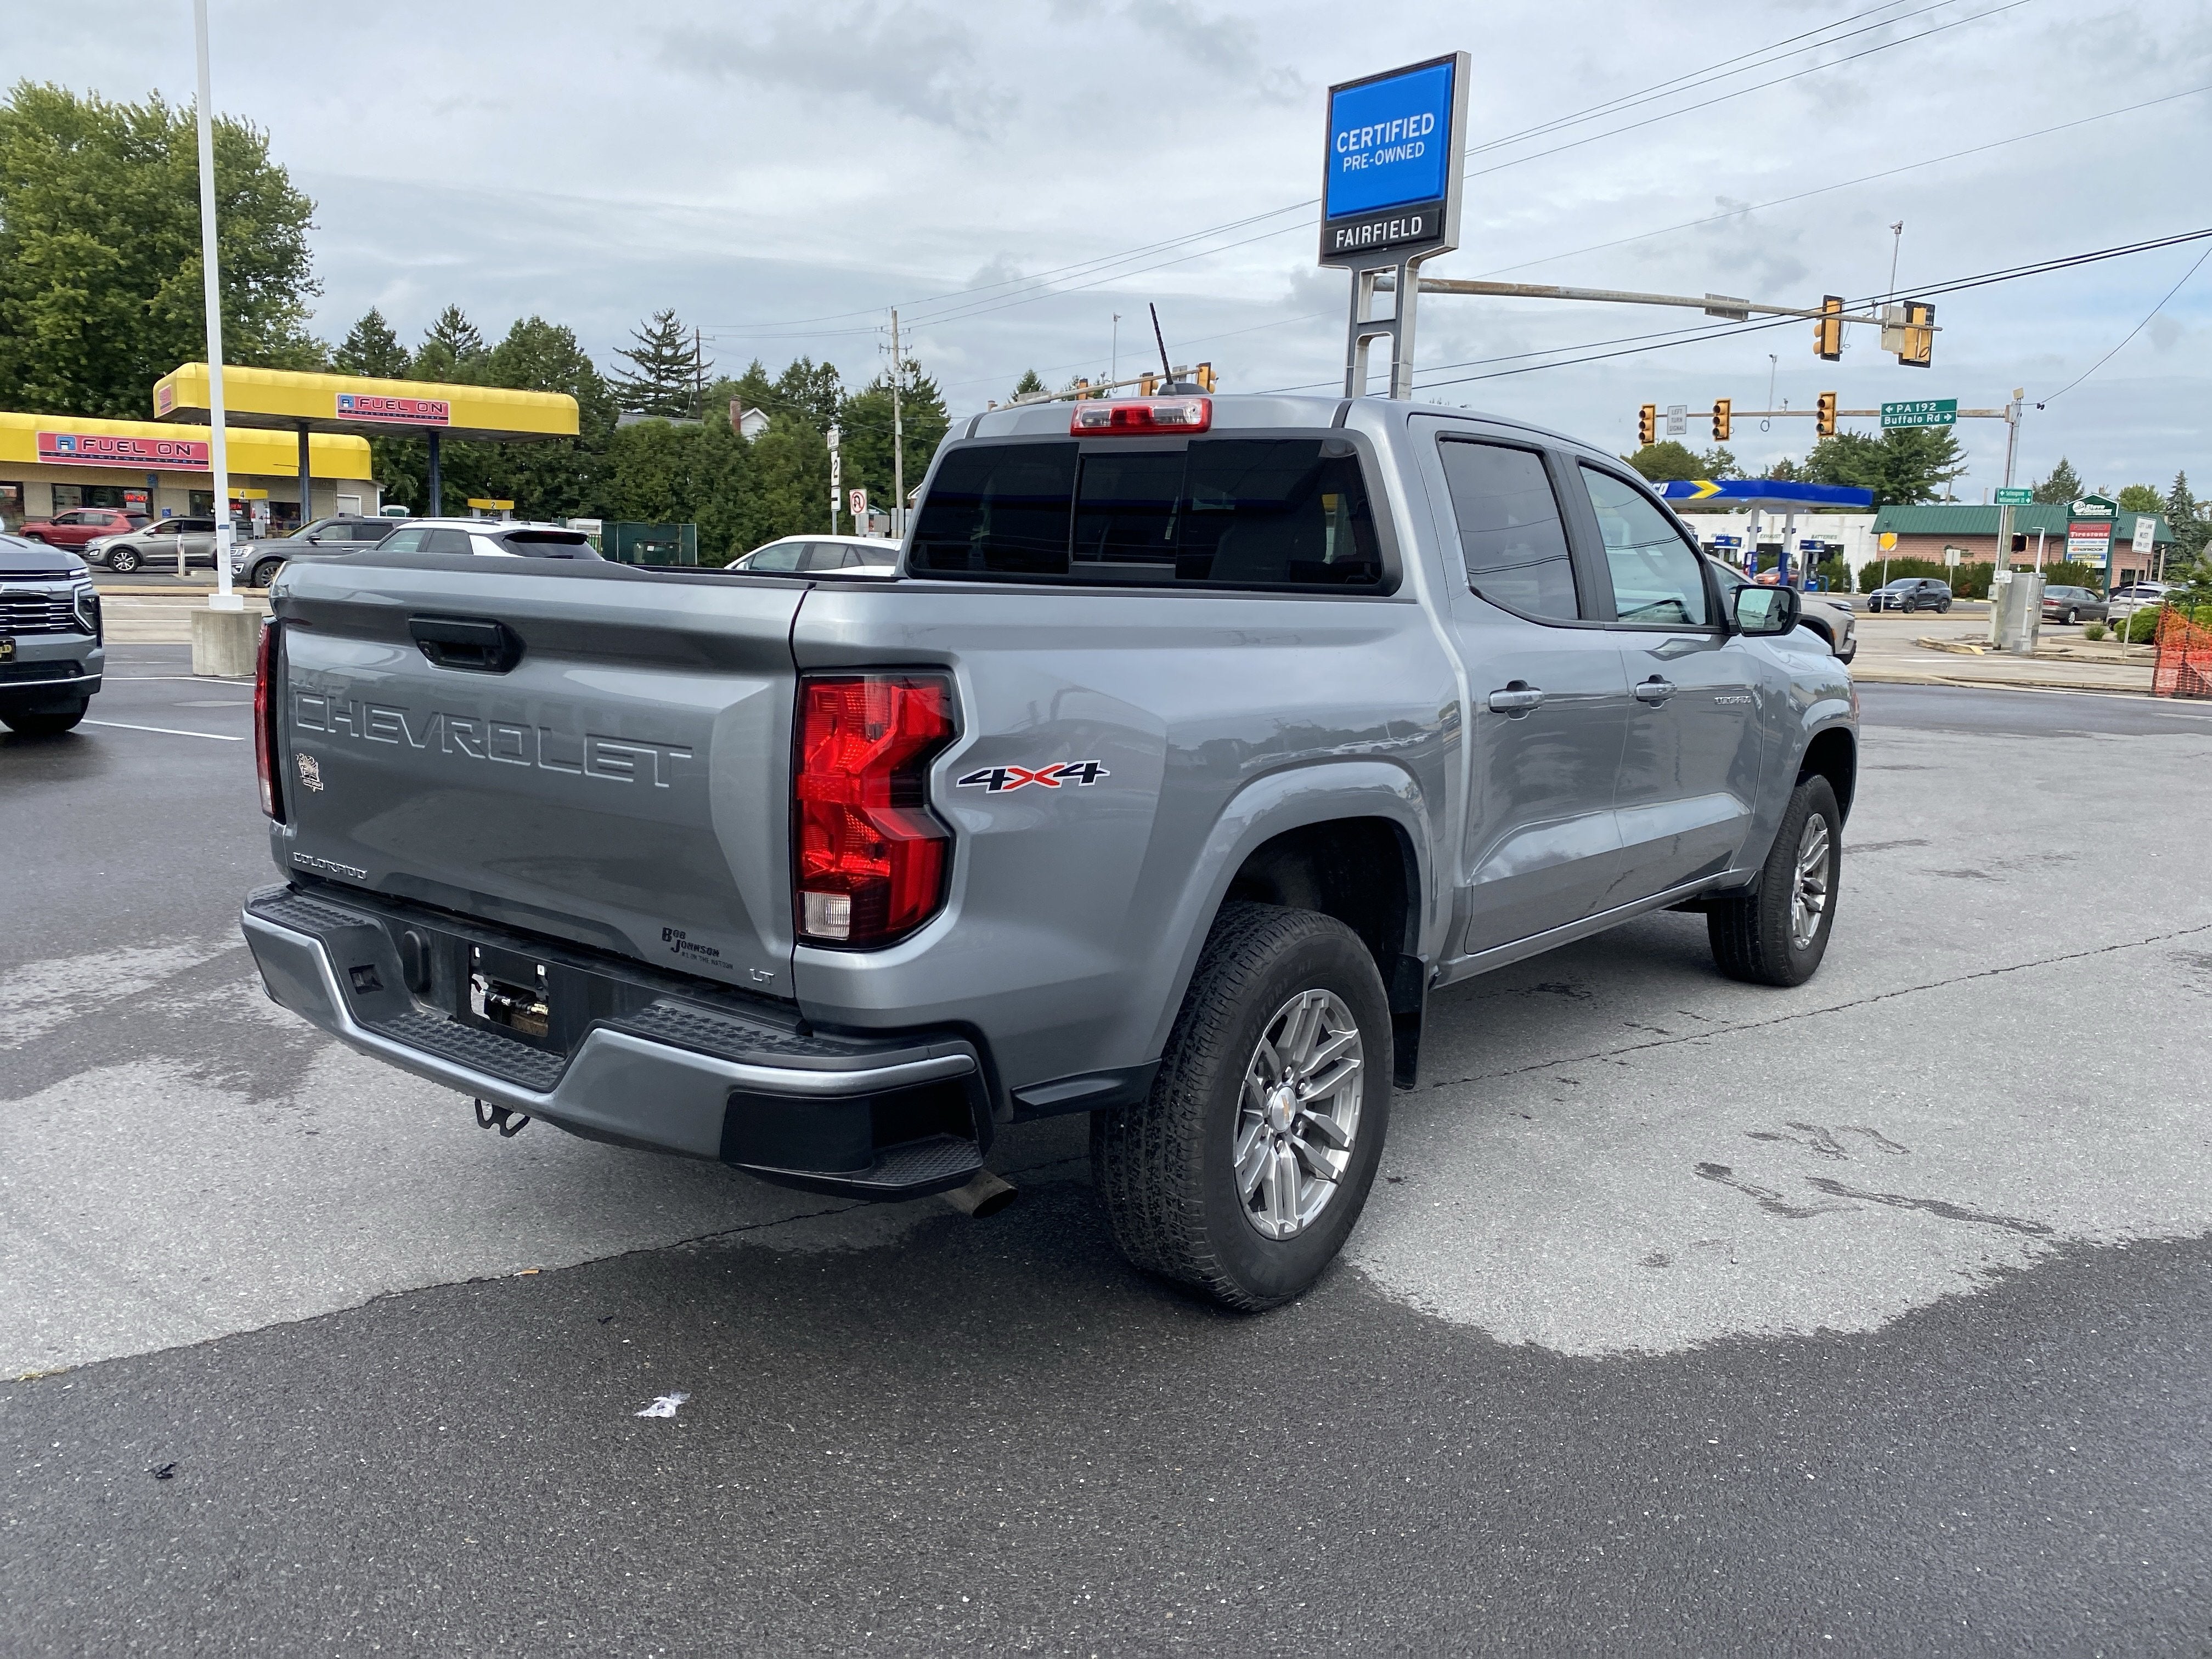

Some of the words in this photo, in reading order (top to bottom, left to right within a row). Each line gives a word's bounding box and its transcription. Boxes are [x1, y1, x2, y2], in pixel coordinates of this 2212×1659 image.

[1336, 113, 1435, 154] CERTIFIED
[1343, 141, 1425, 173] PRE-OWNED
[1335, 216, 1423, 249] FAIRFIELD
[359, 398, 408, 411] FUEL
[417, 402, 443, 413] ON
[1897, 404, 1911, 413] PA
[1916, 402, 1937, 412] 192
[1884, 415, 1922, 425] Buffalo
[1926, 414, 1940, 422] Rd
[83, 439, 146, 453] FUEL
[157, 443, 191, 456] ON
[296, 691, 693, 788] CHEVROLET
[293, 852, 367, 879] COLORADO
[749, 968, 775, 984] LT
